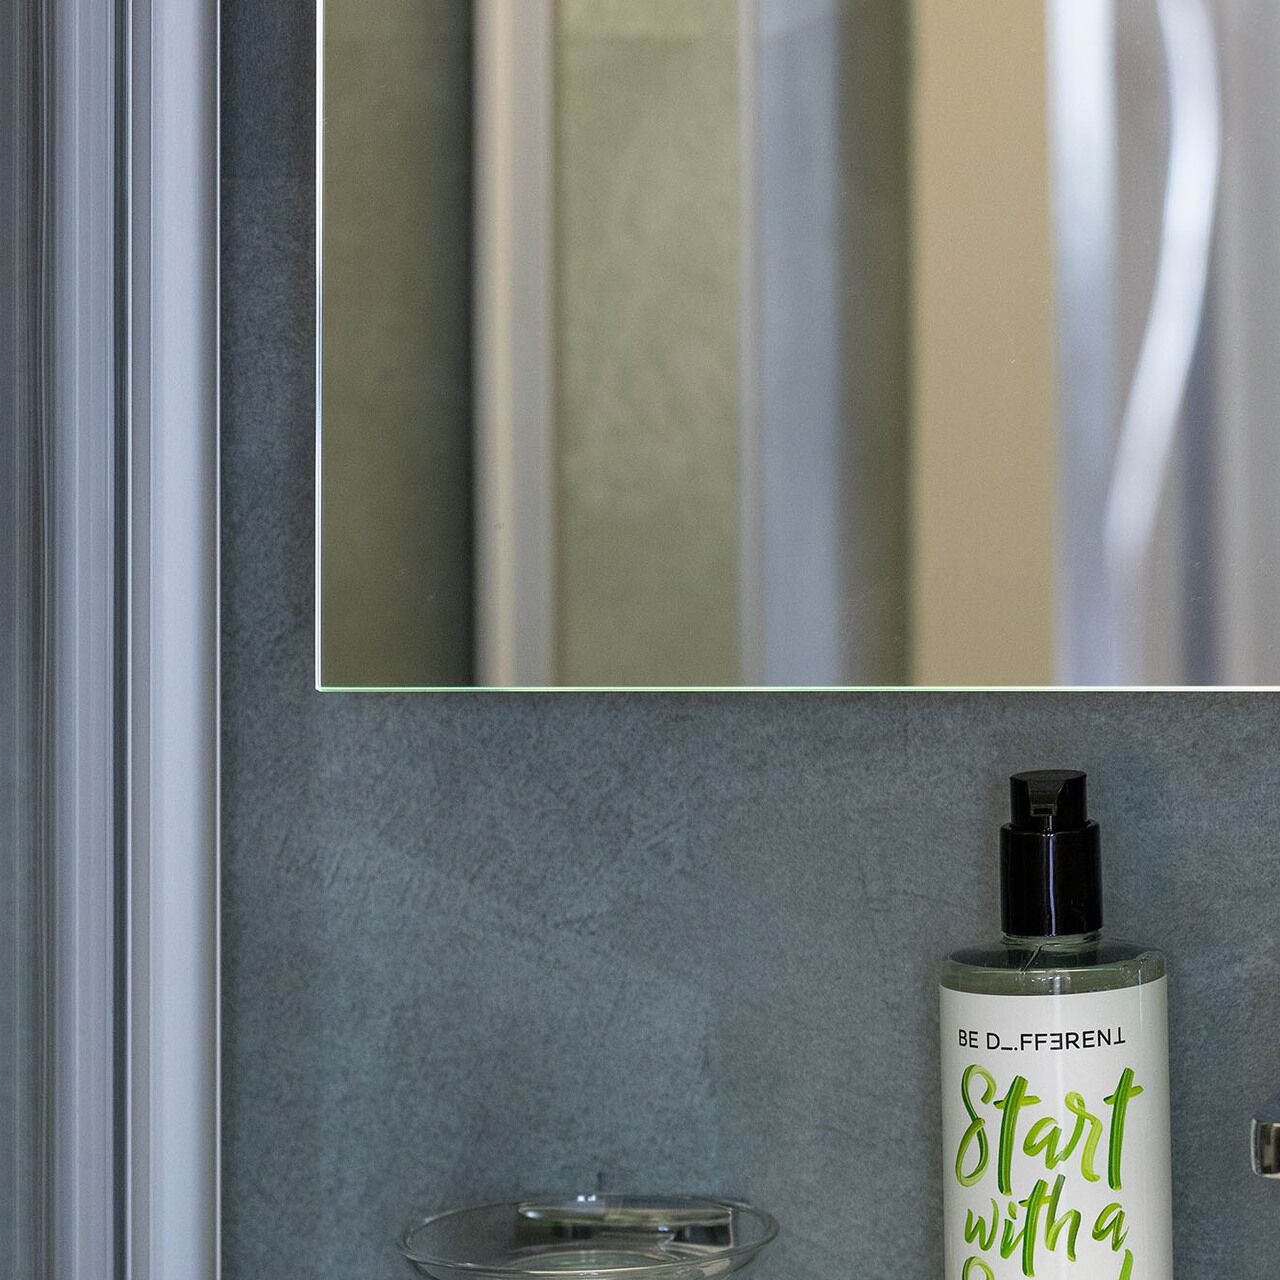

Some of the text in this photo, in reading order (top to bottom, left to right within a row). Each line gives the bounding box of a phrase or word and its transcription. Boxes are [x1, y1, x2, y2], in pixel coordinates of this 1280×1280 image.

[958, 1029, 978, 1049] BE
[955, 1063, 1144, 1196] Start
[964, 1174, 1130, 1278] with a
